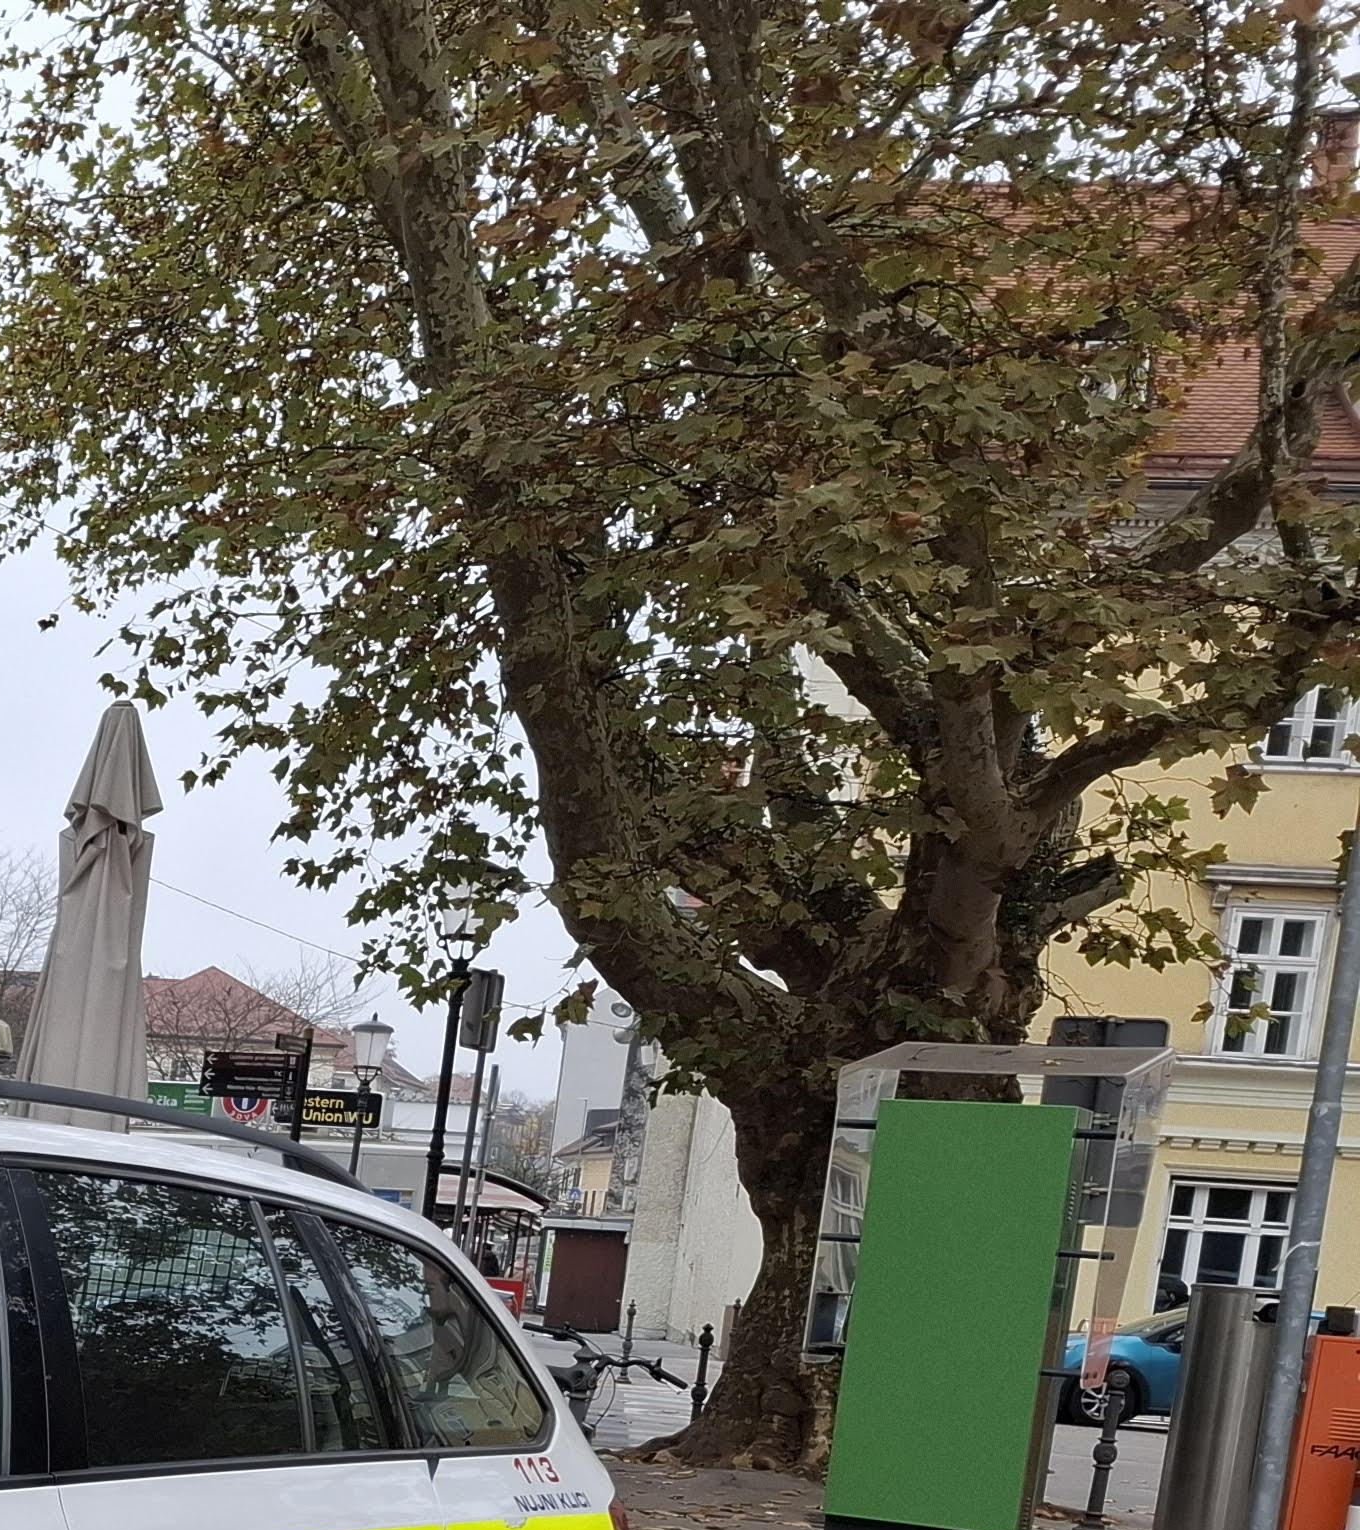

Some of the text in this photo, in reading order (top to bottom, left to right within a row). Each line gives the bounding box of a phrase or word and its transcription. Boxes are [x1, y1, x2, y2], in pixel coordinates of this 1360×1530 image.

[304, 1096, 344, 1109] stern
[302, 1109, 343, 1123] Union
[513, 1456, 560, 1484] 113
[513, 1491, 592, 1513] NUJNI KLICI
